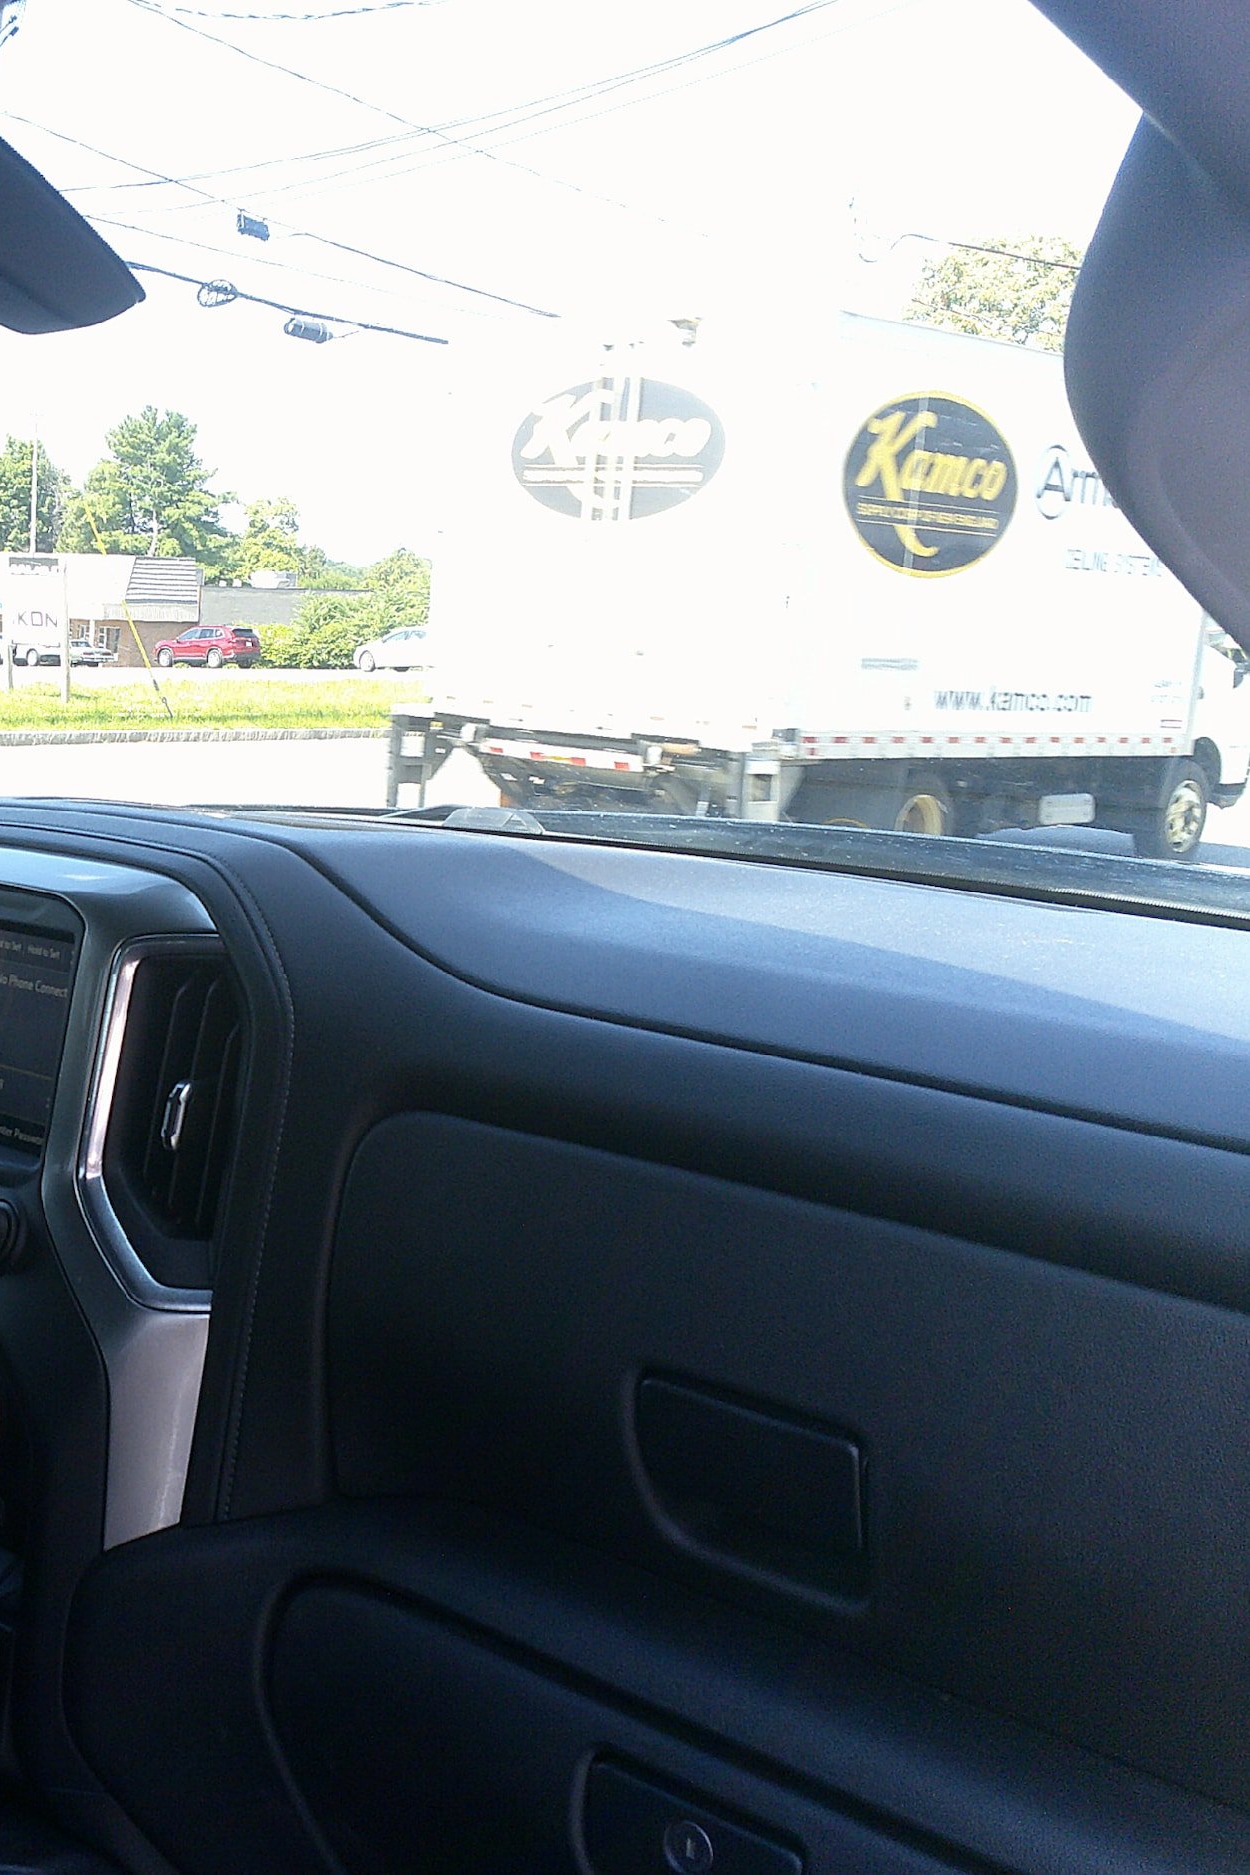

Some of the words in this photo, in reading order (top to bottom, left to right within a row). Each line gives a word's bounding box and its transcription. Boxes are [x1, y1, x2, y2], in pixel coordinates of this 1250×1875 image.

[519, 389, 712, 510] Kamco
[855, 411, 1008, 556] Kamco
[934, 684, 1092, 712] www.kamco.com
[9, 975, 34, 991] Phone
